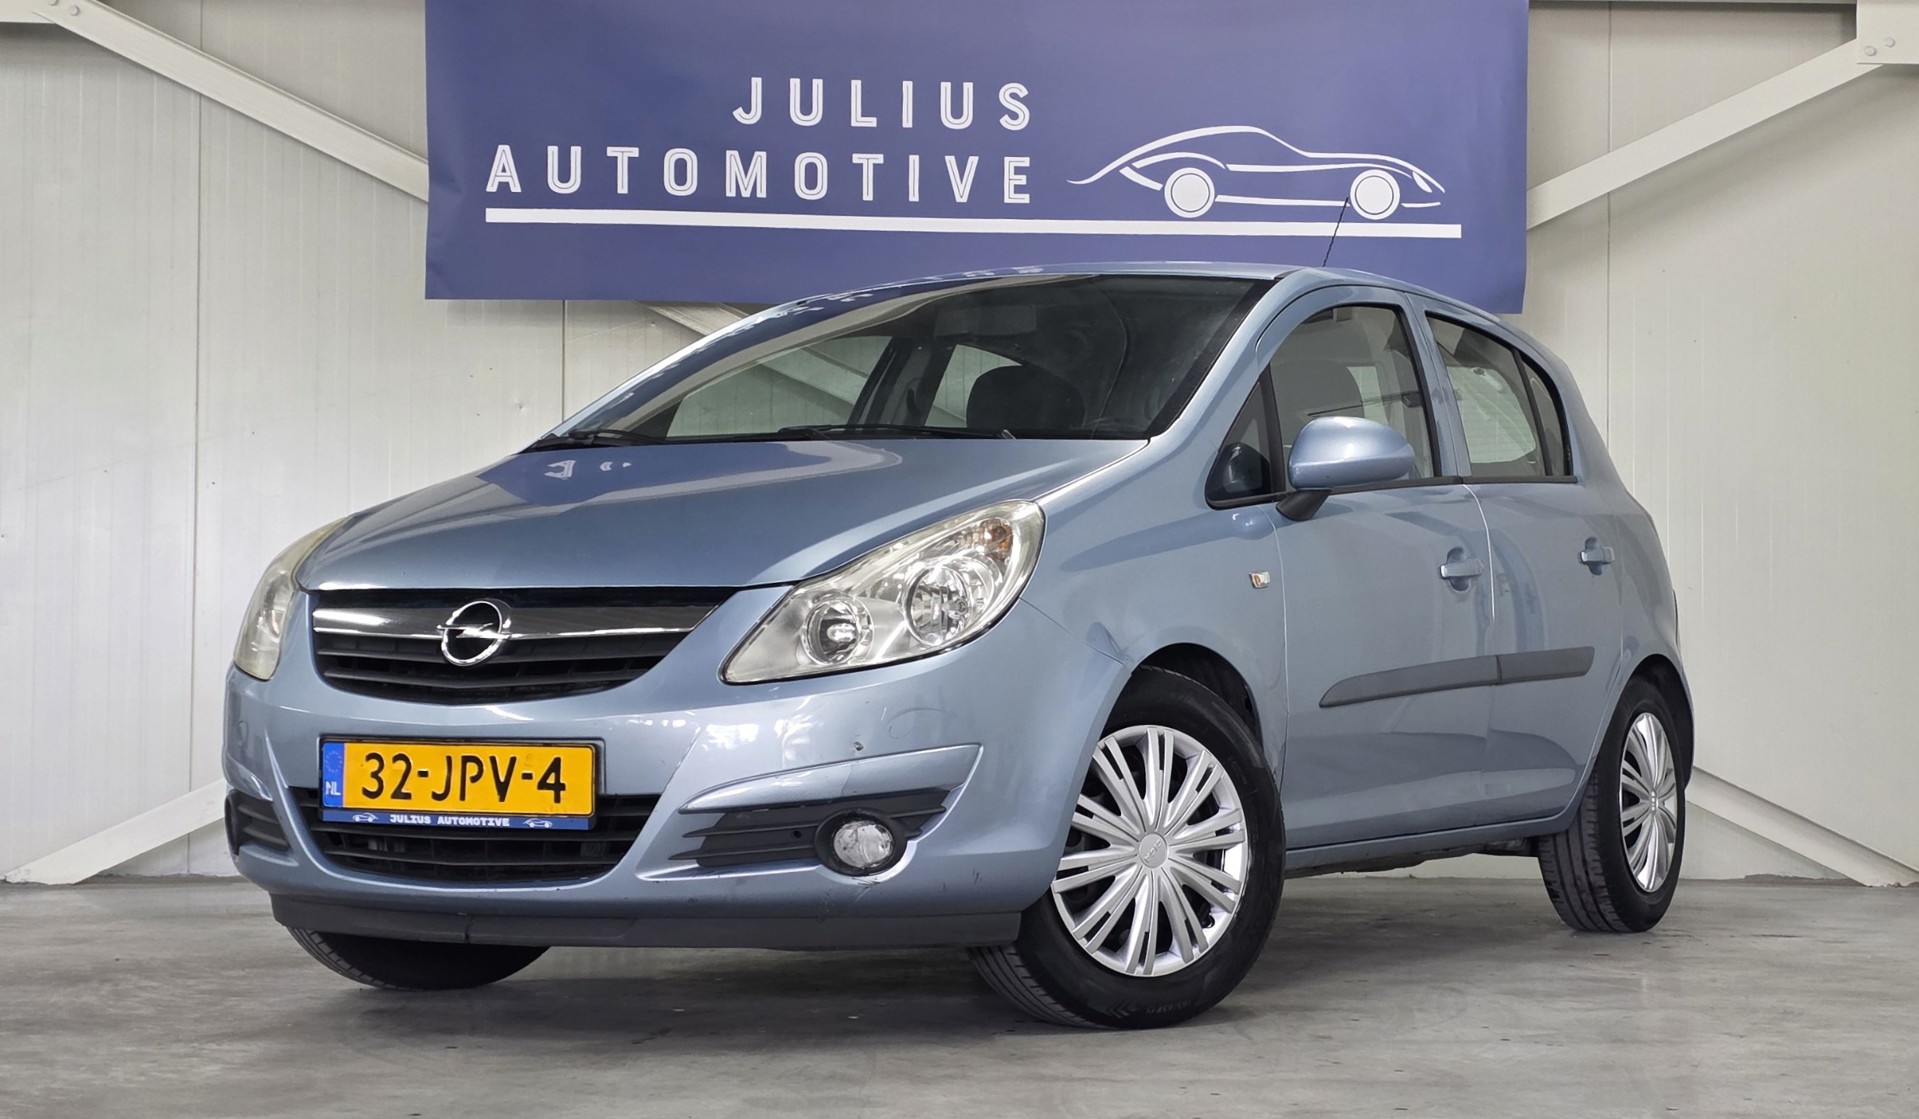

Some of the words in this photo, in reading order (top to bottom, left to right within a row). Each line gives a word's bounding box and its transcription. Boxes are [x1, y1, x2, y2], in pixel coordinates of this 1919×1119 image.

[732, 76, 1031, 131] JULIUS
[485, 144, 1031, 204] AUTOMOTIVE
[325, 781, 341, 796] NL
[361, 752, 567, 804] 32-JPV-4
[389, 813, 432, 826] JULIUS
[436, 815, 511, 828] AUTOMOTIVE
